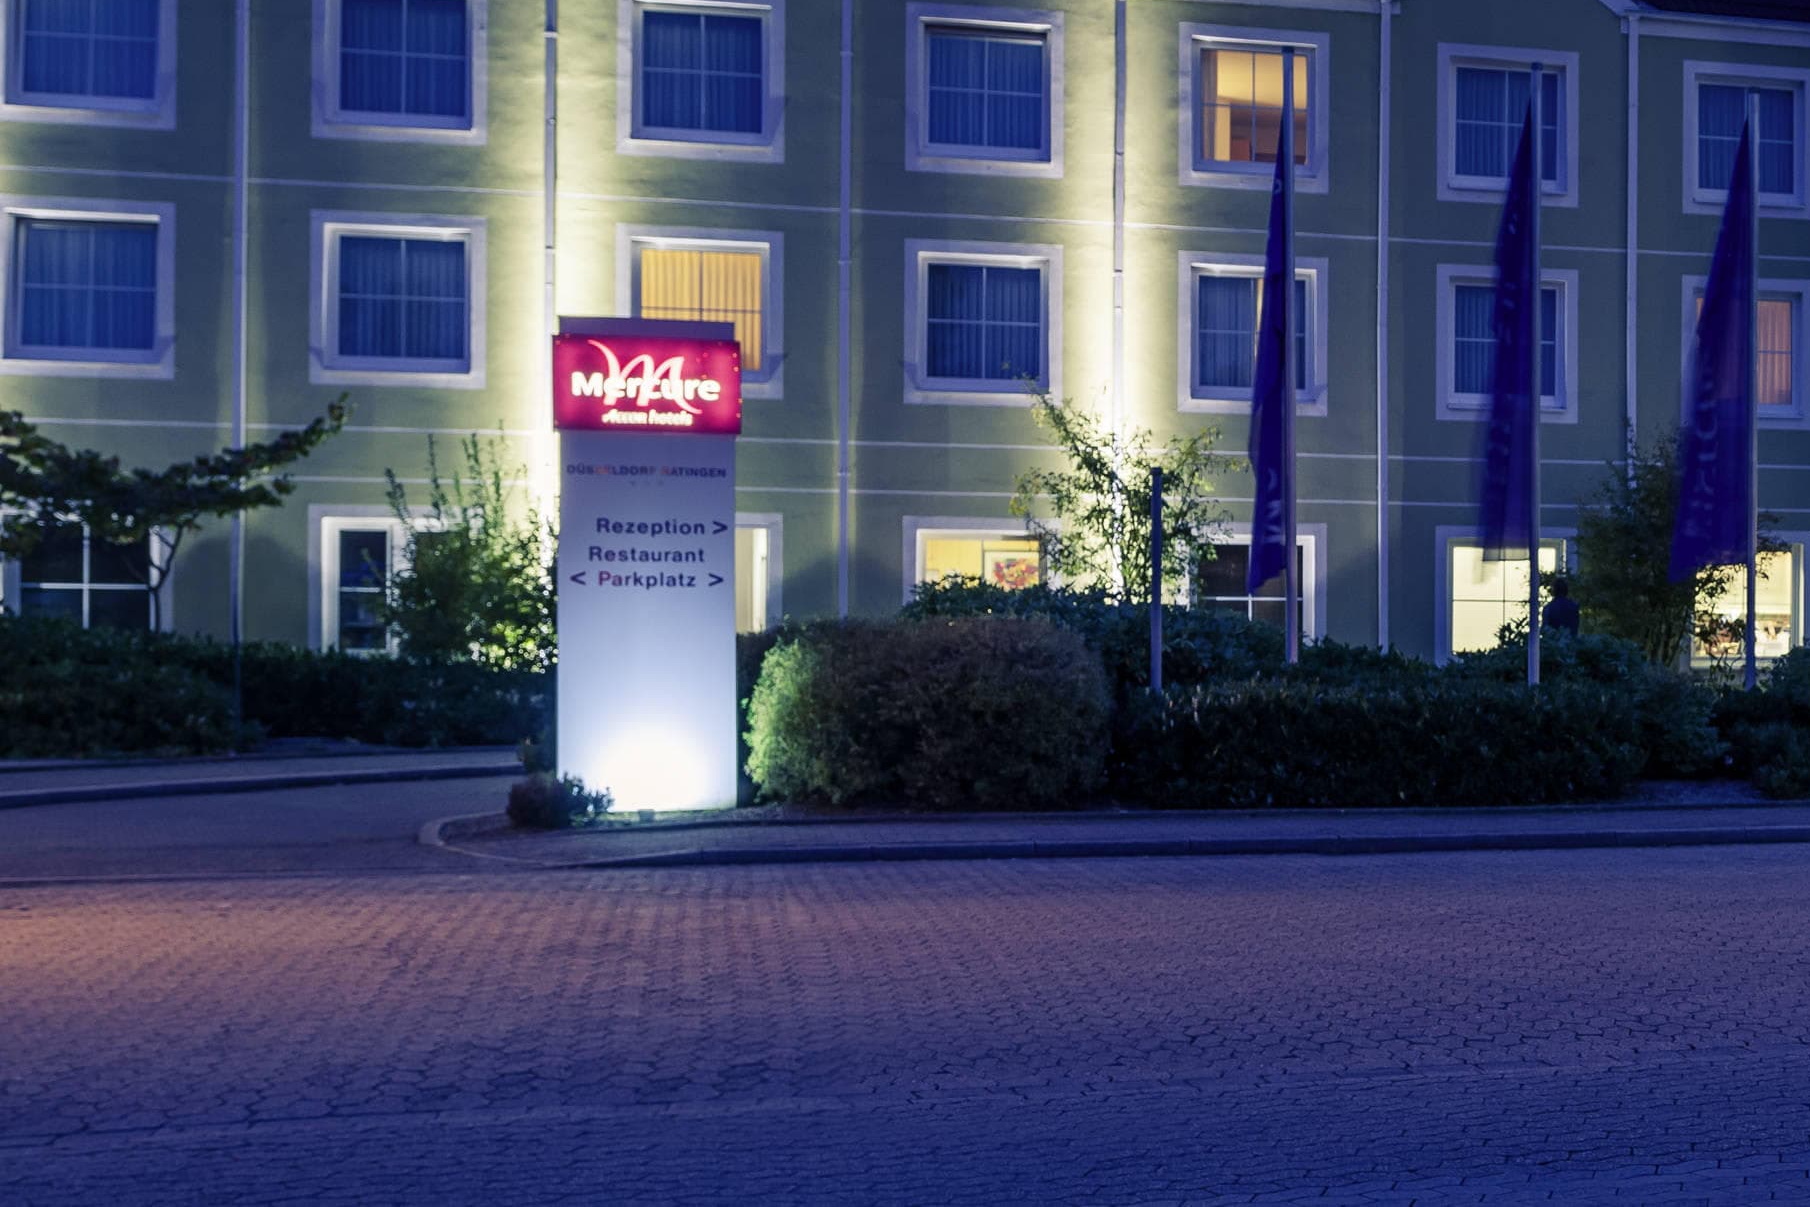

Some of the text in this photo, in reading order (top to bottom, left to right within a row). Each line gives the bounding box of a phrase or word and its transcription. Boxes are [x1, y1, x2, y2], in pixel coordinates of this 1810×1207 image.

[571, 371, 721, 402] Mercure
[595, 517, 705, 537] Rezeption
[588, 546, 705, 563] Restaurant
[598, 570, 696, 590] Parkplatz
